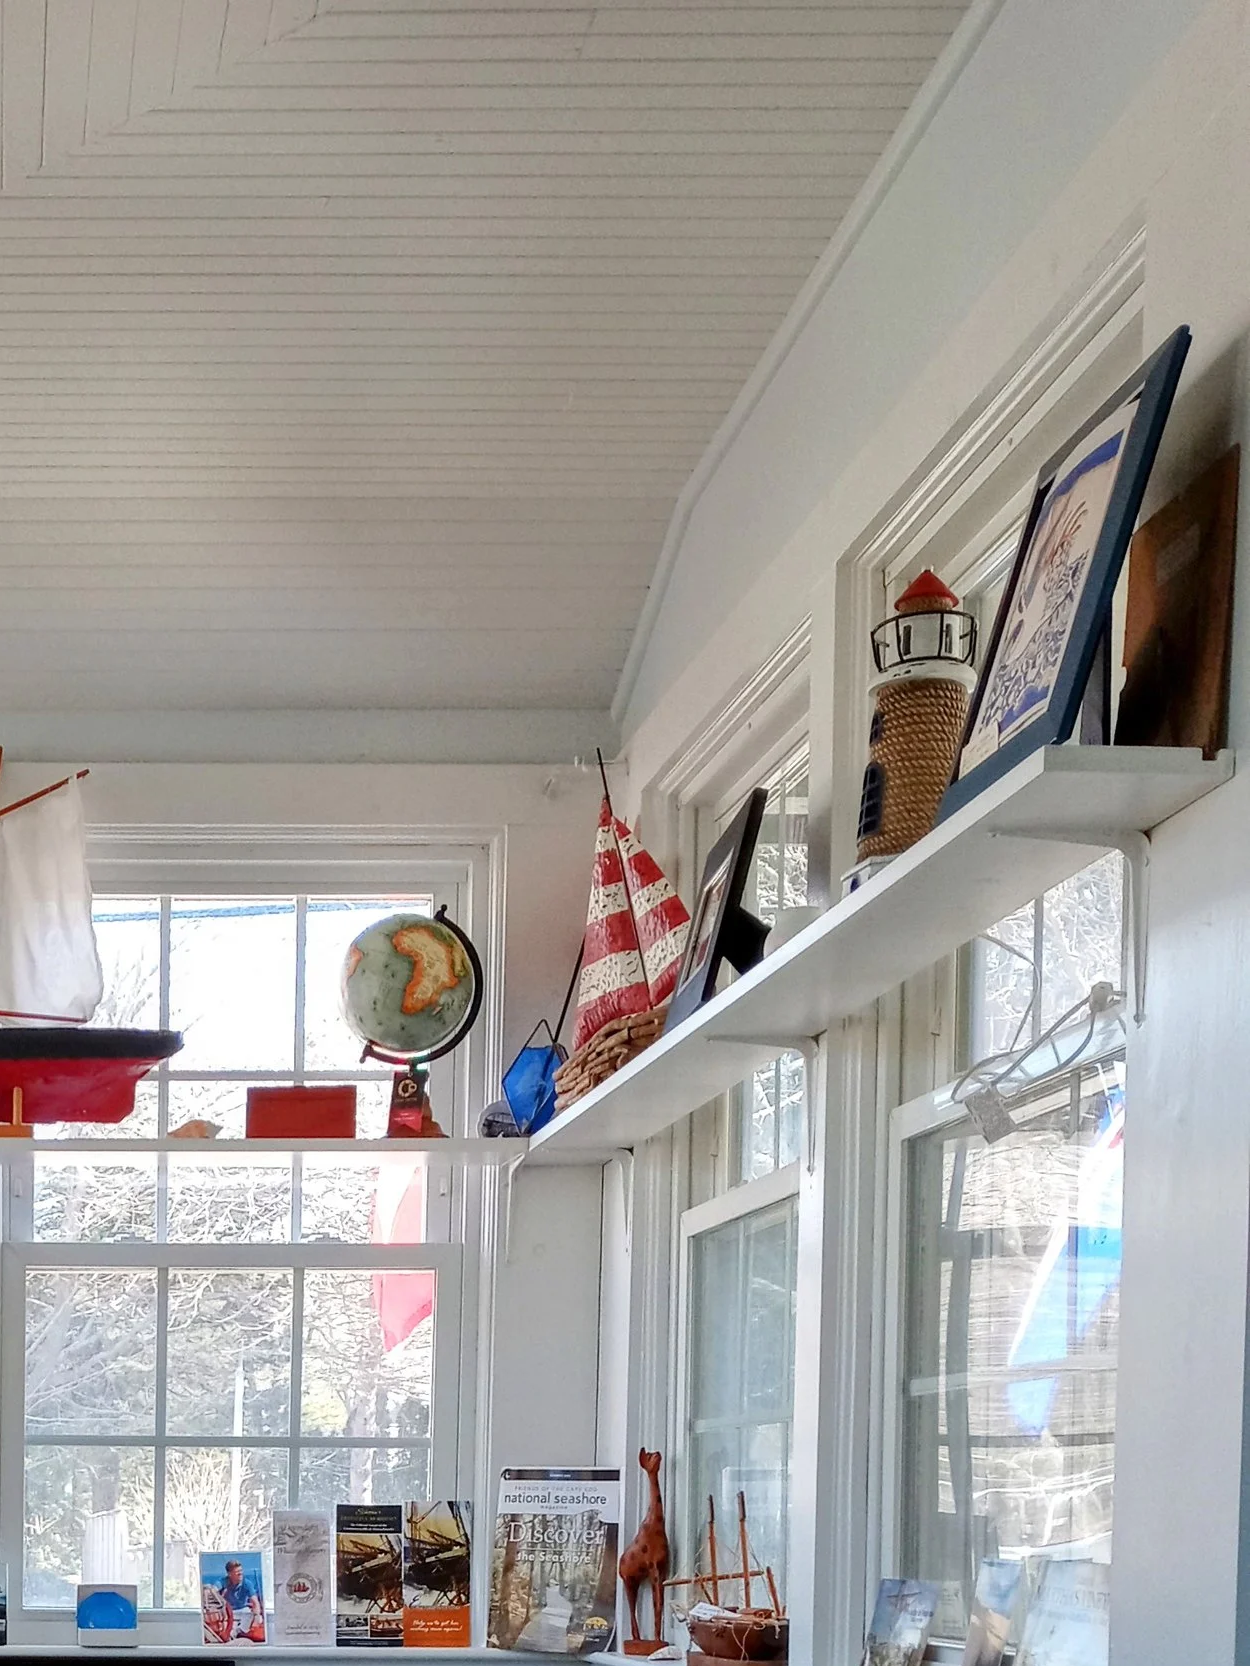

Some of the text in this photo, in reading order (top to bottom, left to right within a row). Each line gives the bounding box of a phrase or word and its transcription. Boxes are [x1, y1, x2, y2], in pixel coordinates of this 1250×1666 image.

[504, 1491, 607, 1504] national seashore
[508, 1522, 606, 1545] Discover
[516, 1551, 592, 1564] the Seashore
